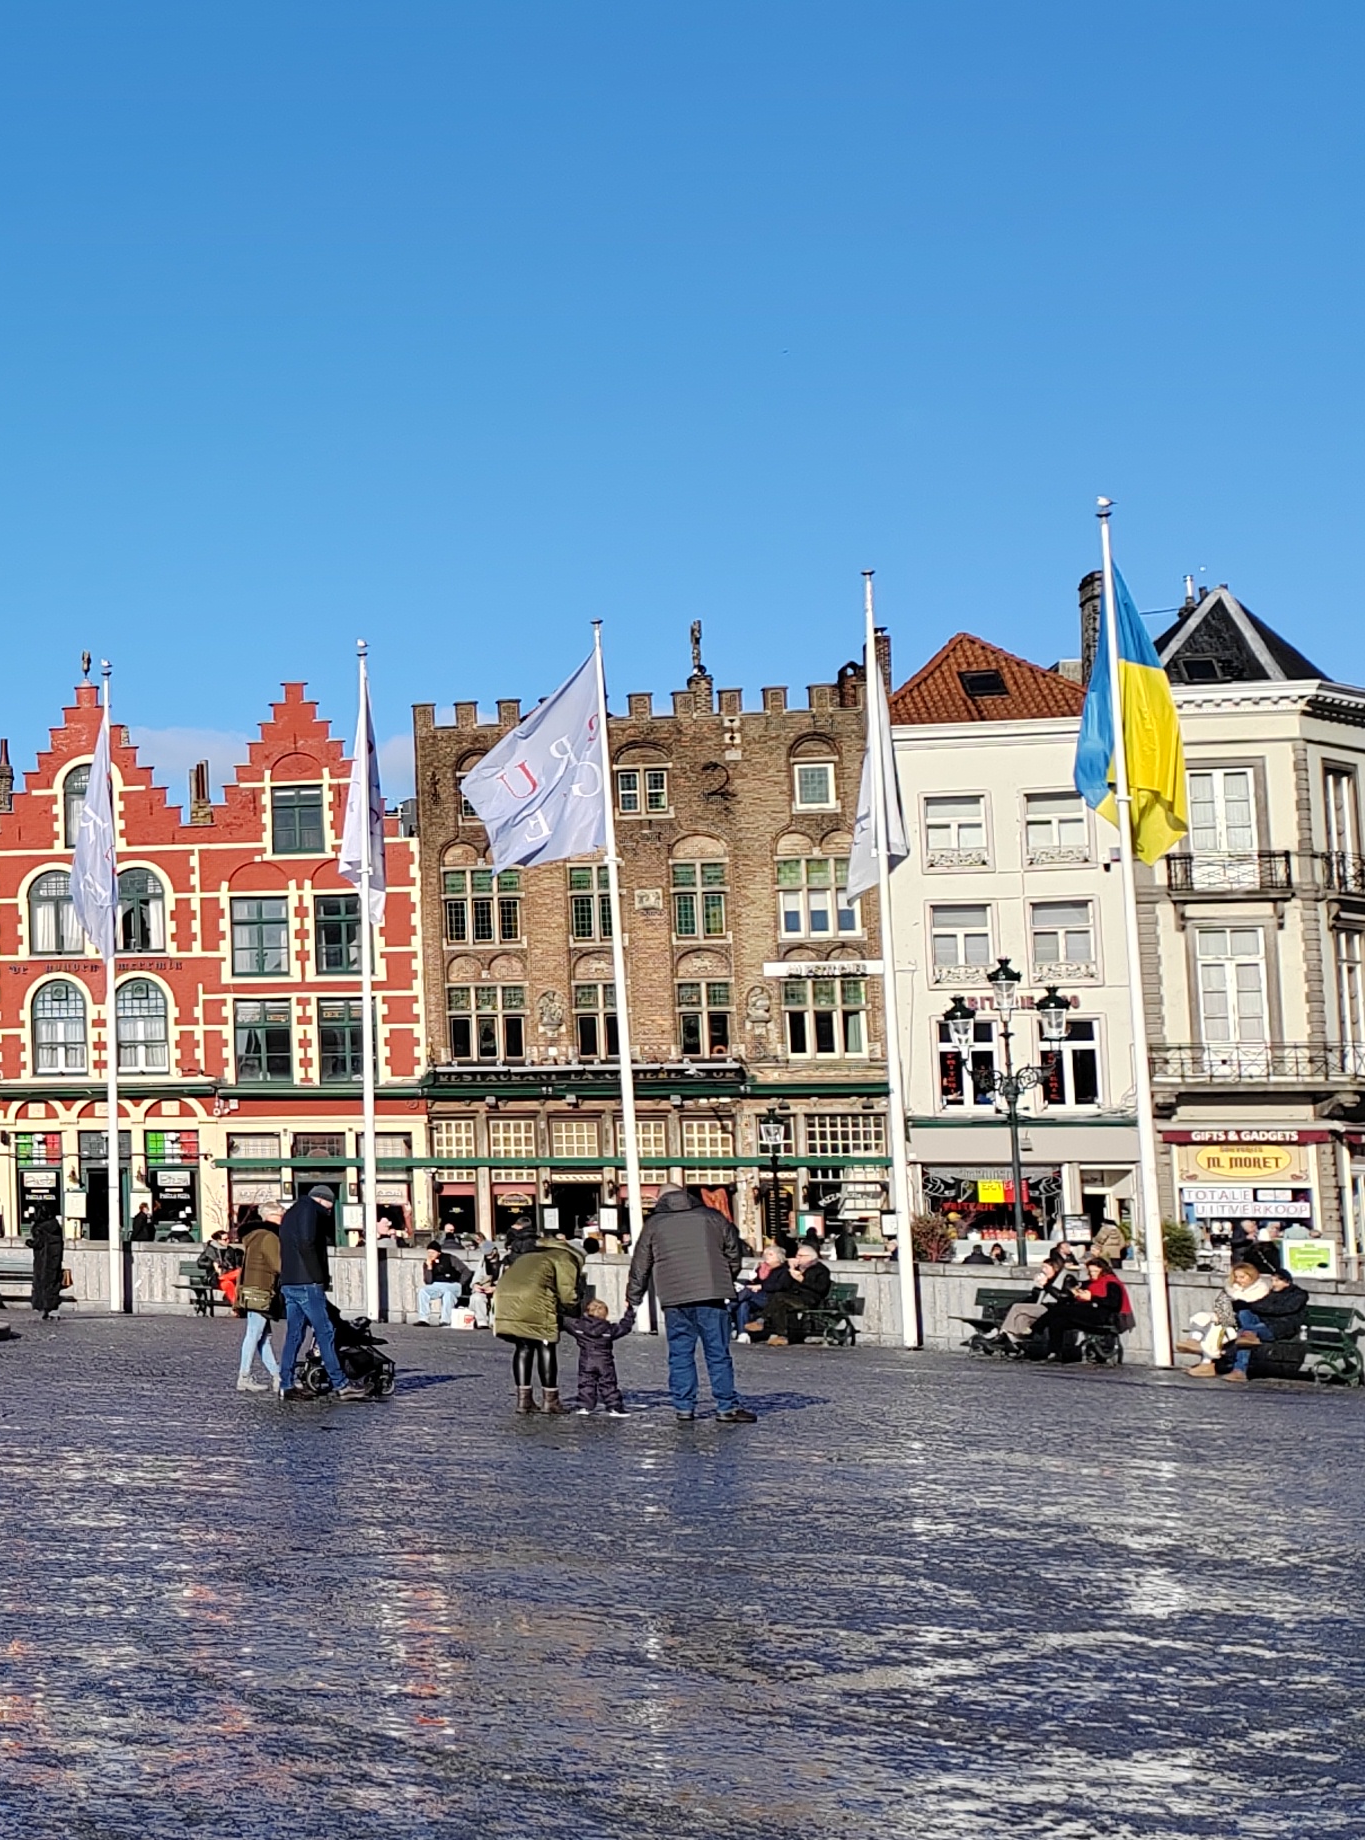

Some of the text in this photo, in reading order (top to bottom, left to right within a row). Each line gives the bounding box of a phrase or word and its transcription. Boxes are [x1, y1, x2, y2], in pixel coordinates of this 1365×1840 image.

[439, 1074, 557, 1082] RESTAURANT
[1191, 1130, 1299, 1142] GIFTS & GADGETS
[1229, 1156, 1283, 1170] MORET
[1186, 1190, 1252, 1201] TOTALE
[1196, 1204, 1308, 1217] UITVERKOOP
